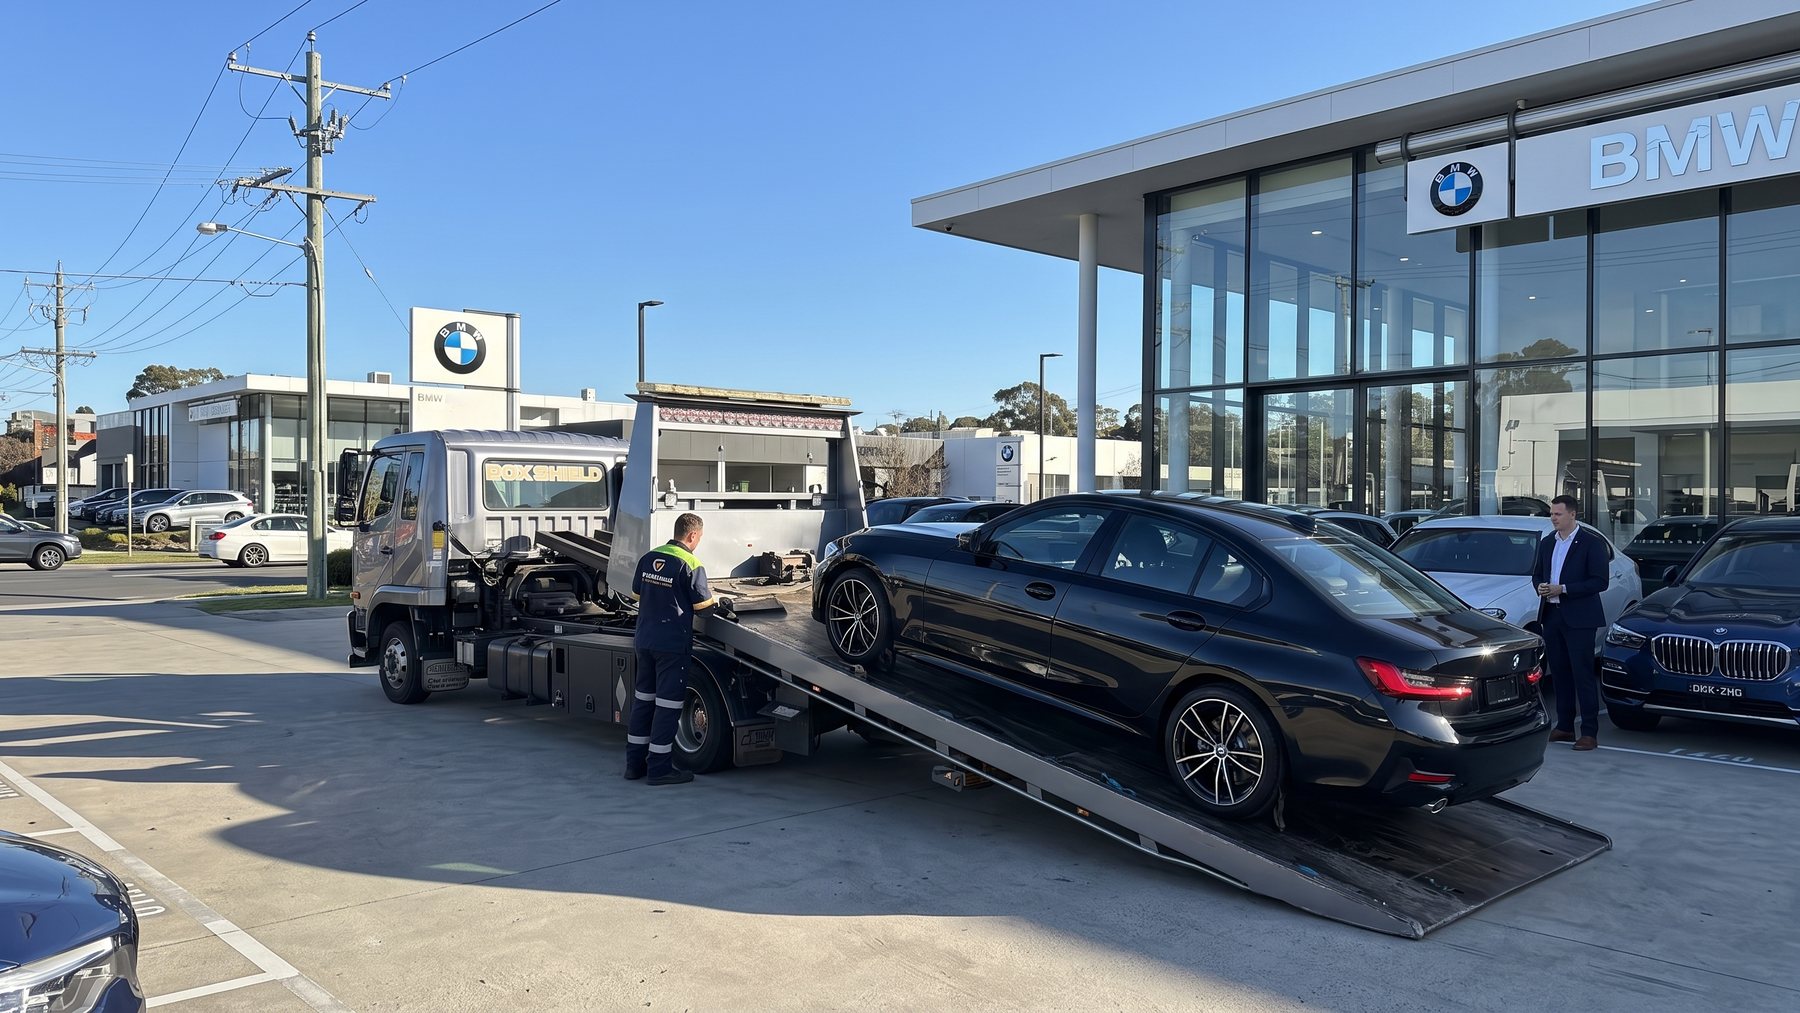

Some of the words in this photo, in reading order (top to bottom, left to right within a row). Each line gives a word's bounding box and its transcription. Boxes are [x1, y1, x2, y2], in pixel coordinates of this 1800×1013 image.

[1590, 99, 1800, 190] BMW
[1435, 163, 1478, 183] BMW
[440, 322, 483, 341] BMW
[417, 393, 442, 402] BMW
[533, 464, 602, 482] SHIELD
